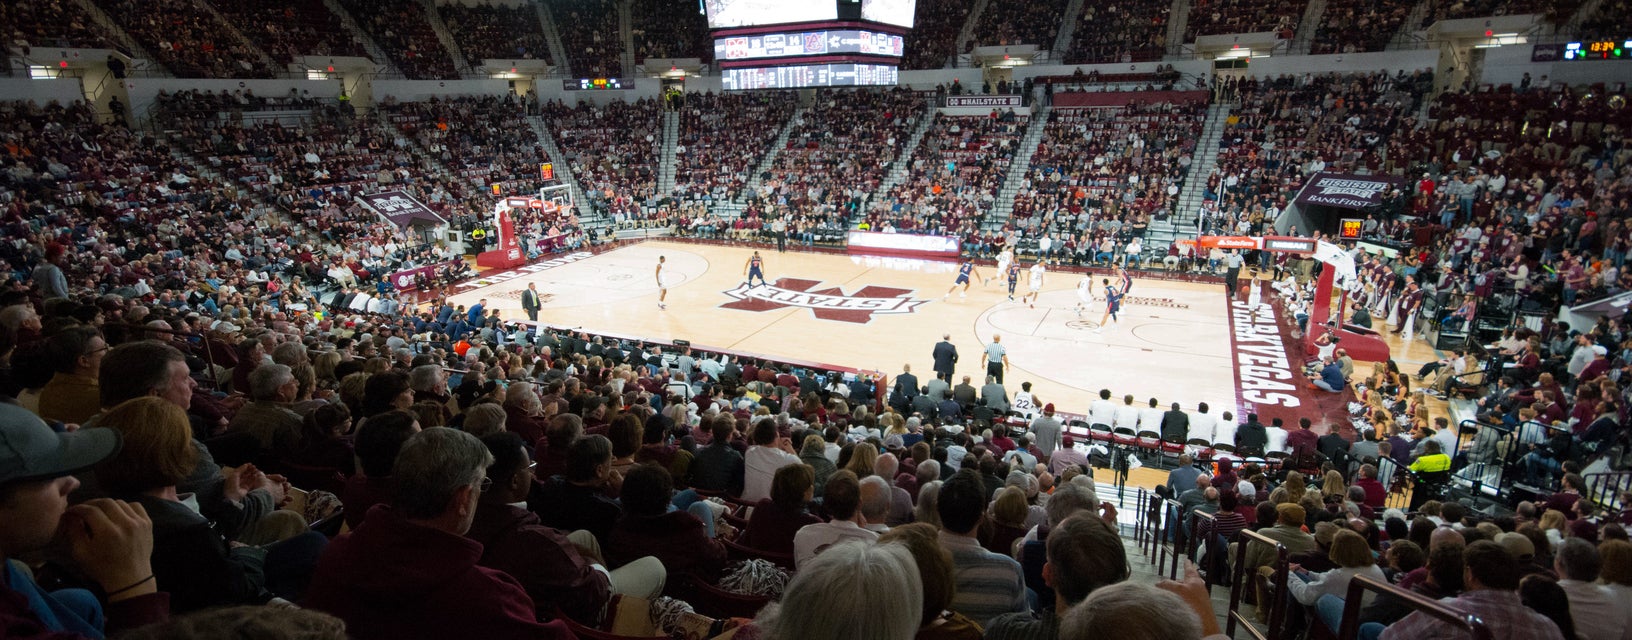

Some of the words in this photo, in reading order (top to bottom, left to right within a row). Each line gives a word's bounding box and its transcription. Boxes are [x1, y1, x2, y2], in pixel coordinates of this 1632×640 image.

[1591, 42, 1615, 51] 13:39
[1345, 228, 1357, 237] 30
[750, 285, 893, 311] STATE
[1016, 399, 1030, 409] 22
